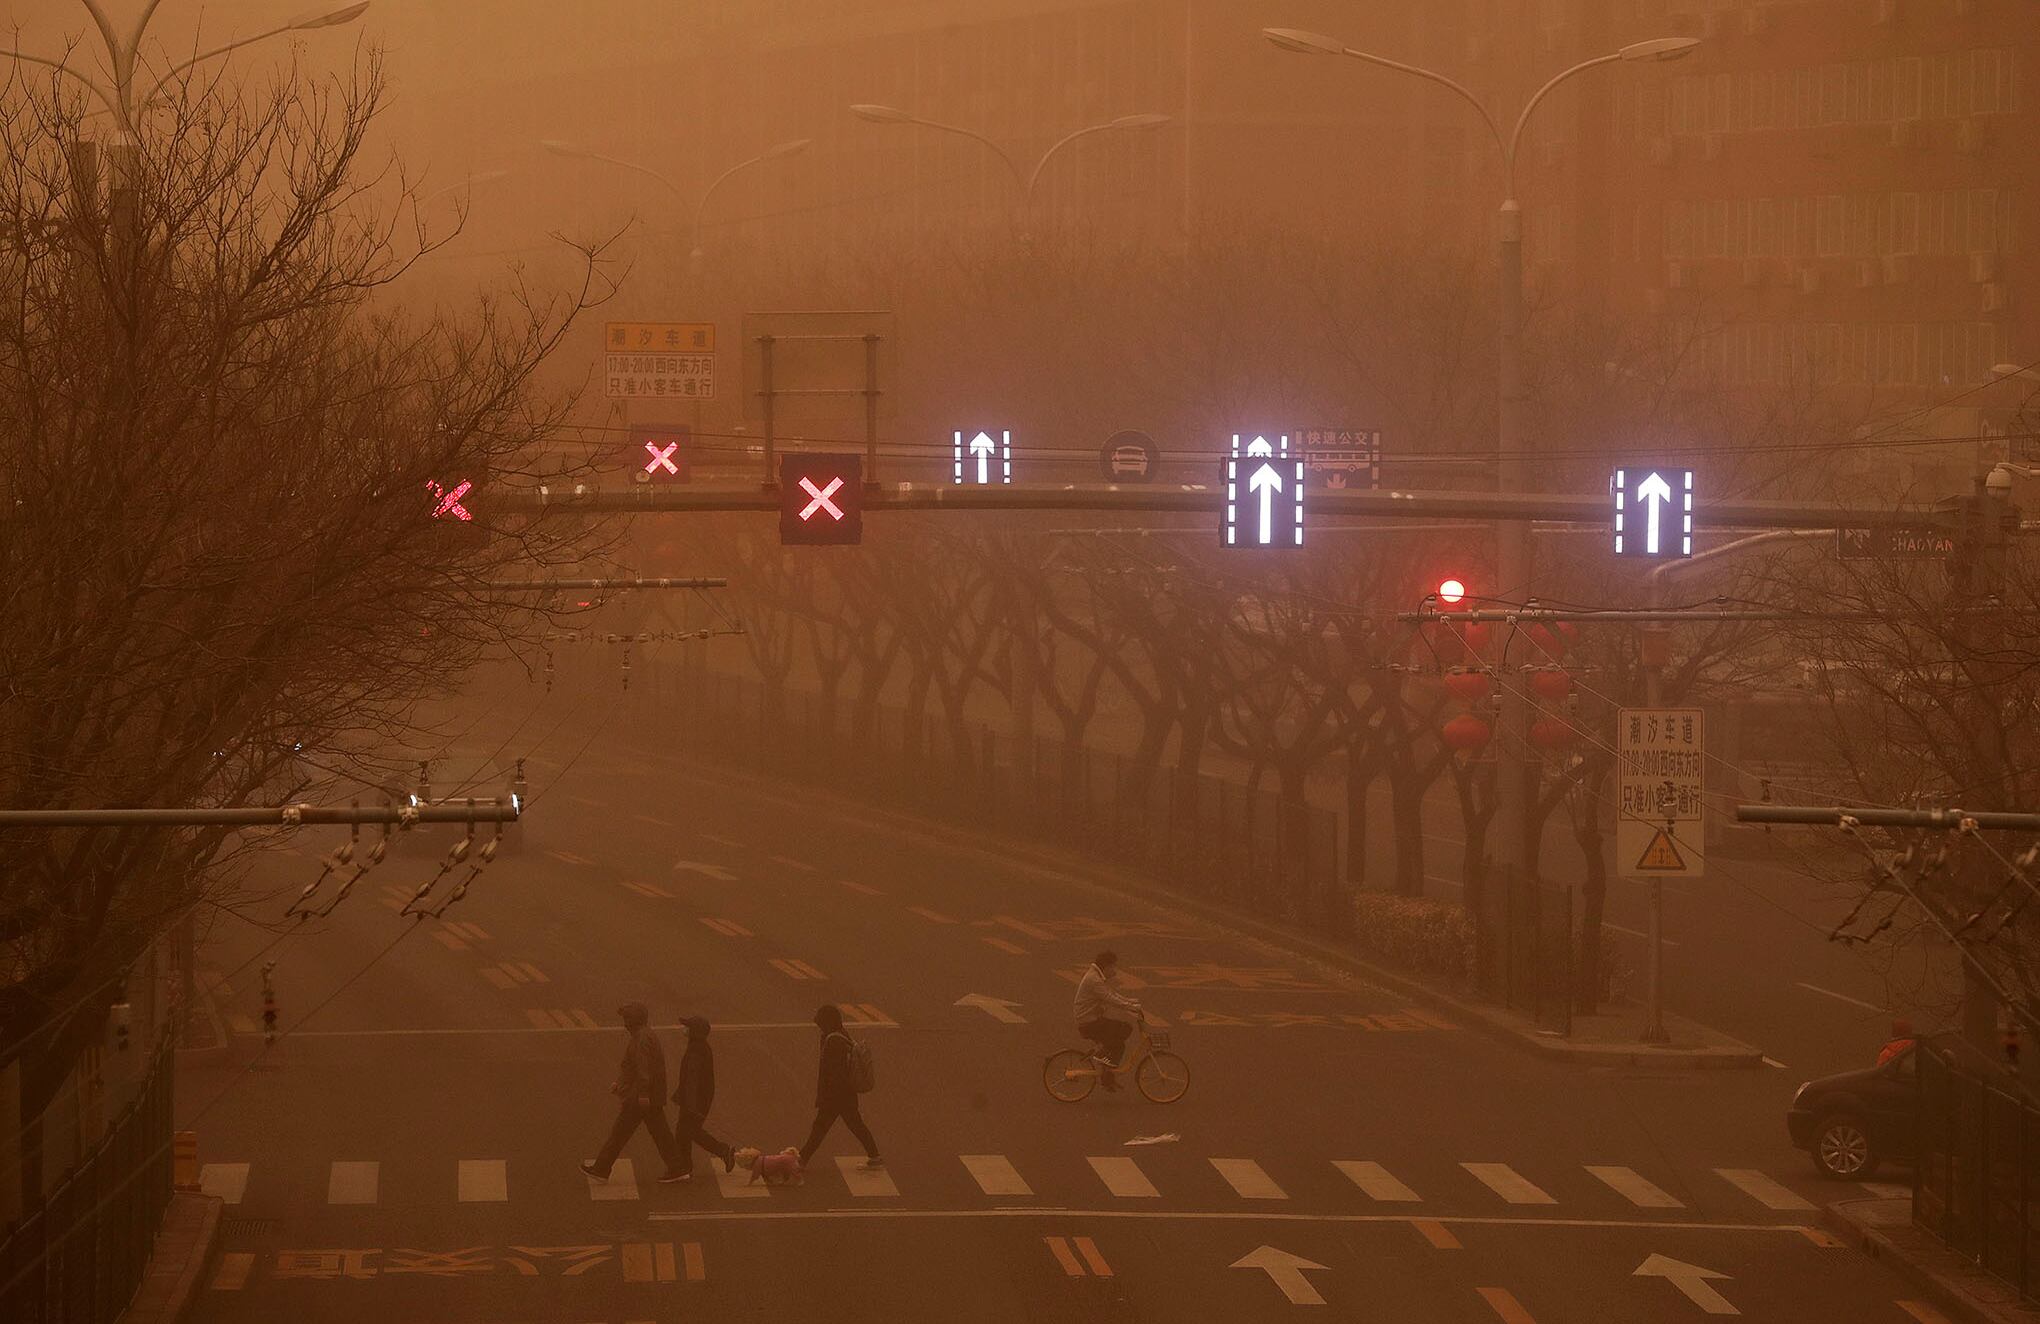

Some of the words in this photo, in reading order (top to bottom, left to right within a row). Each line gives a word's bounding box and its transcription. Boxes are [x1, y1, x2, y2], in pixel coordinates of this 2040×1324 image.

[609, 377, 712, 396] 只准小客车通行
[1629, 714, 1694, 744] 潮汐车道
